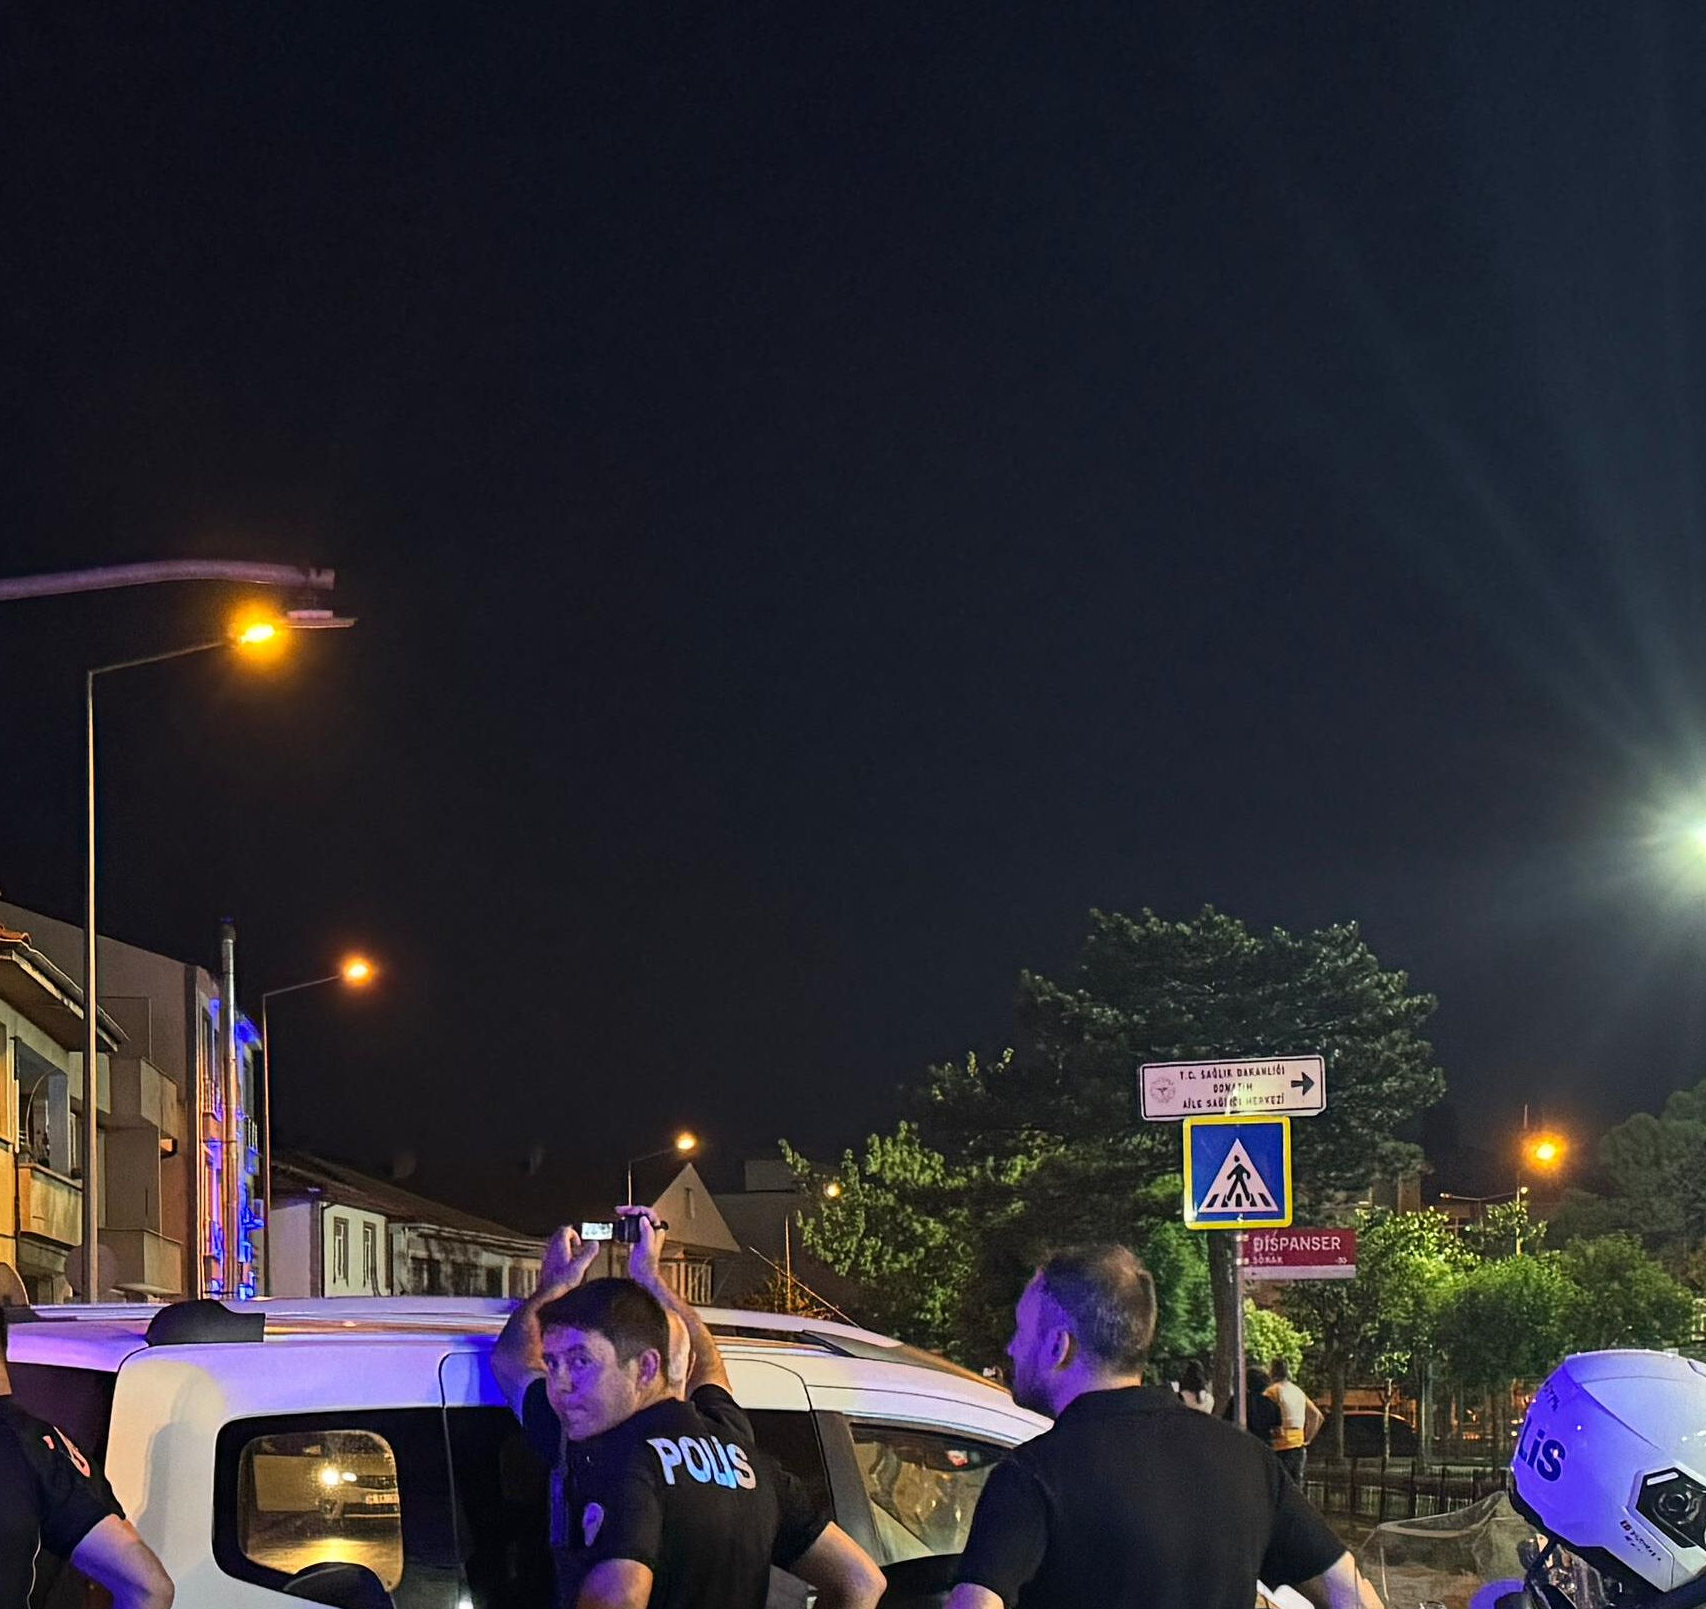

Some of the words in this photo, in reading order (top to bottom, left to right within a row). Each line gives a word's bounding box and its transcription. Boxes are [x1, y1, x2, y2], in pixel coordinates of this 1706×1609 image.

[1201, 1066, 1233, 1080] SAĞLIK
[1182, 1098, 1202, 1109] AİLE
[1253, 1234, 1341, 1252] DİSPANSER
